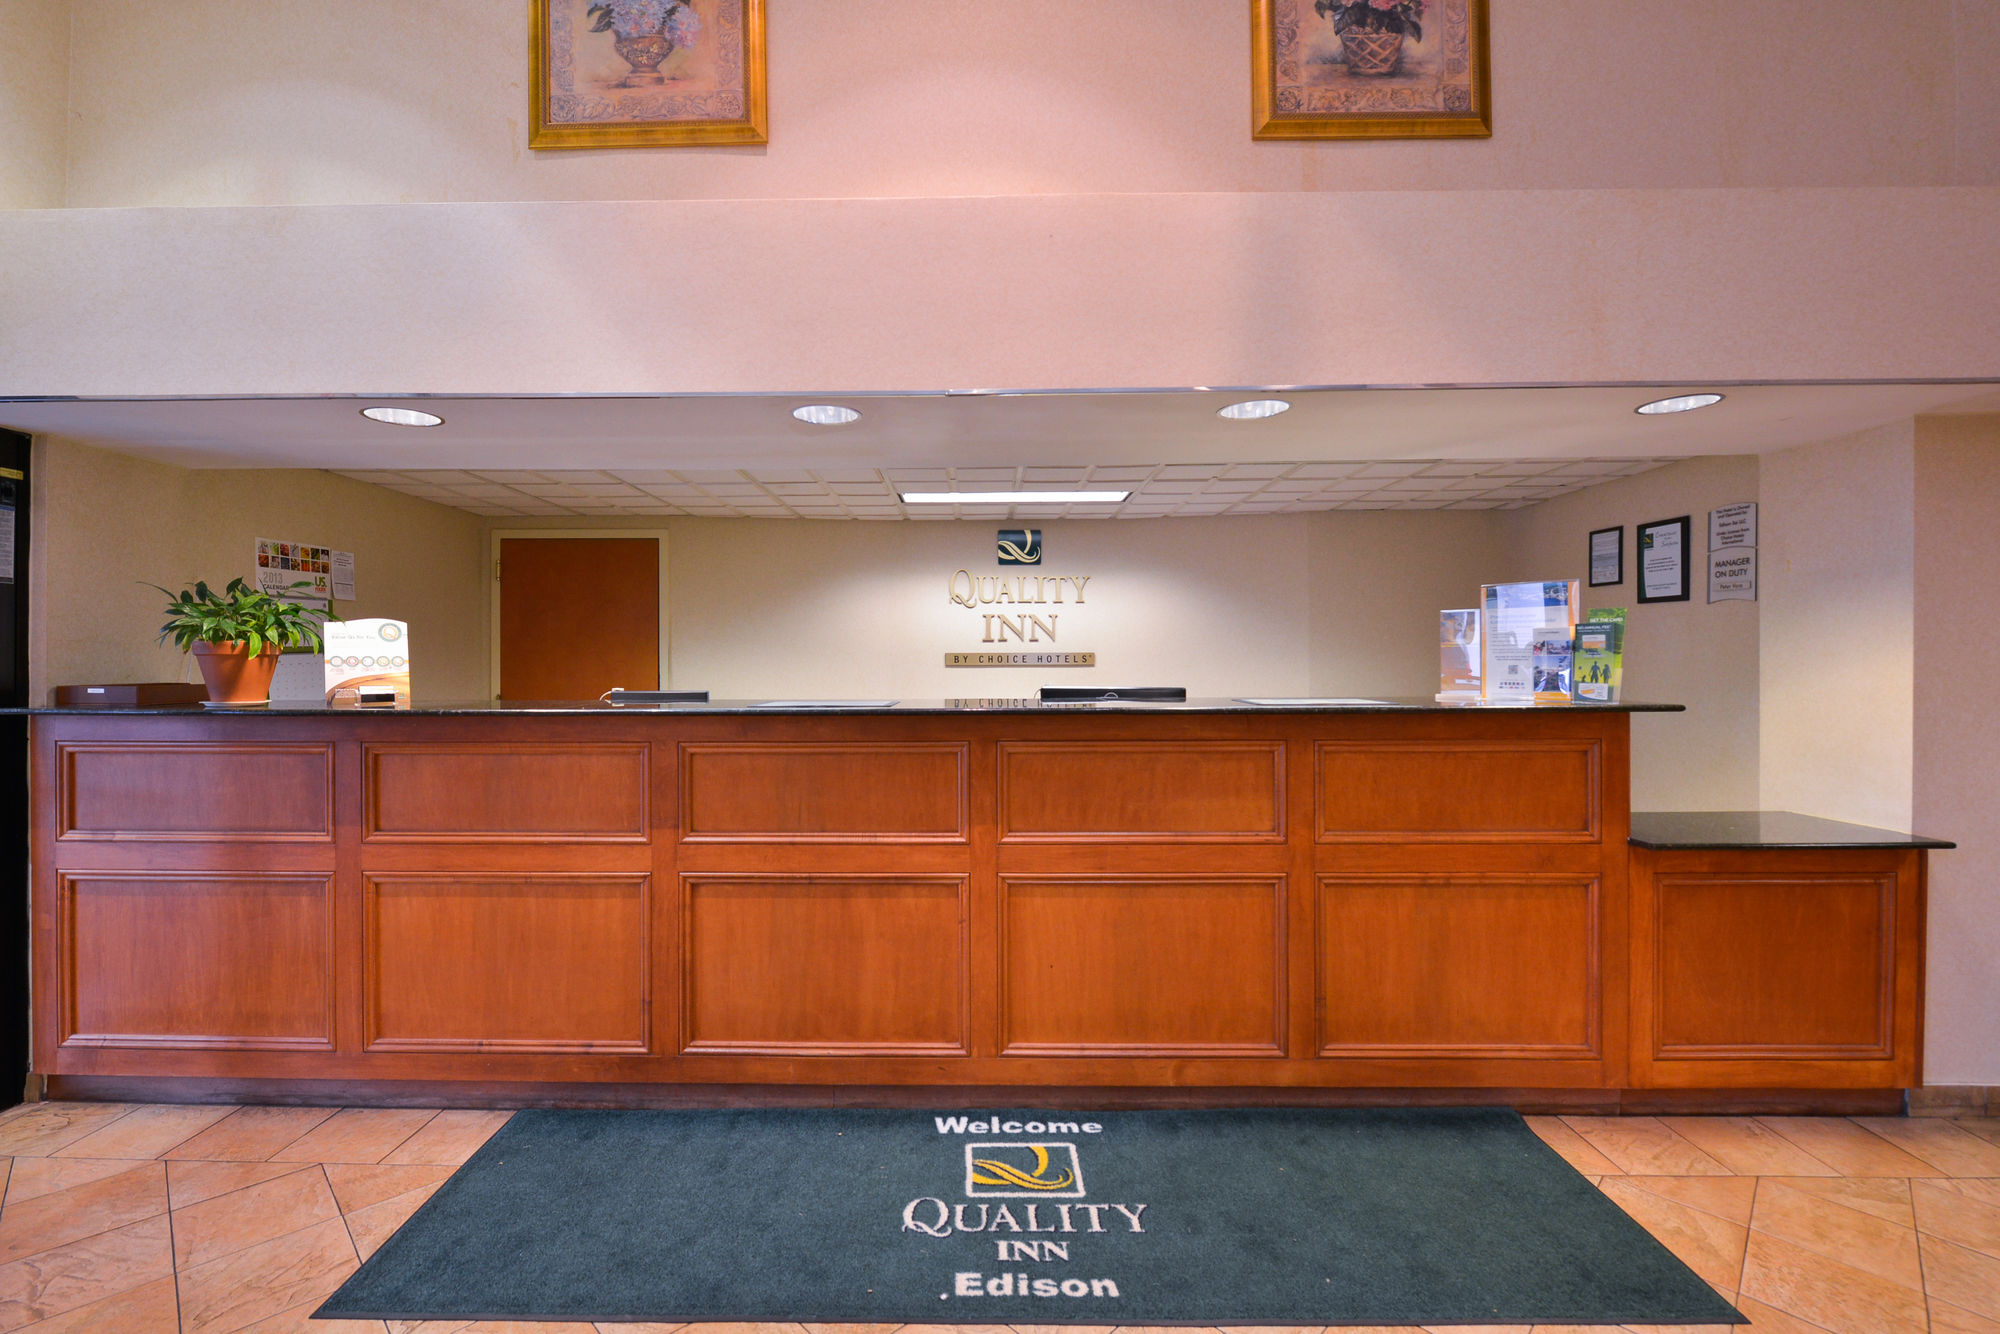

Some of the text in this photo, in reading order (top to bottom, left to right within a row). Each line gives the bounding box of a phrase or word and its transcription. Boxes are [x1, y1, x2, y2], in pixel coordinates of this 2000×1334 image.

[1715, 557, 1751, 568] MANAGER
[263, 571, 283, 583] 2013
[1714, 568, 1748, 579] ON DUTY
[949, 568, 1092, 609] QUALITY
[982, 614, 1058, 643] INN
[954, 655, 969, 664] BY
[978, 655, 1027, 664] CHOICE
[934, 1116, 1103, 1135] Welcome
[902, 1196, 1147, 1238] QUALITY
[994, 1240, 1071, 1262] INN
[954, 1271, 1121, 1298] Edison
